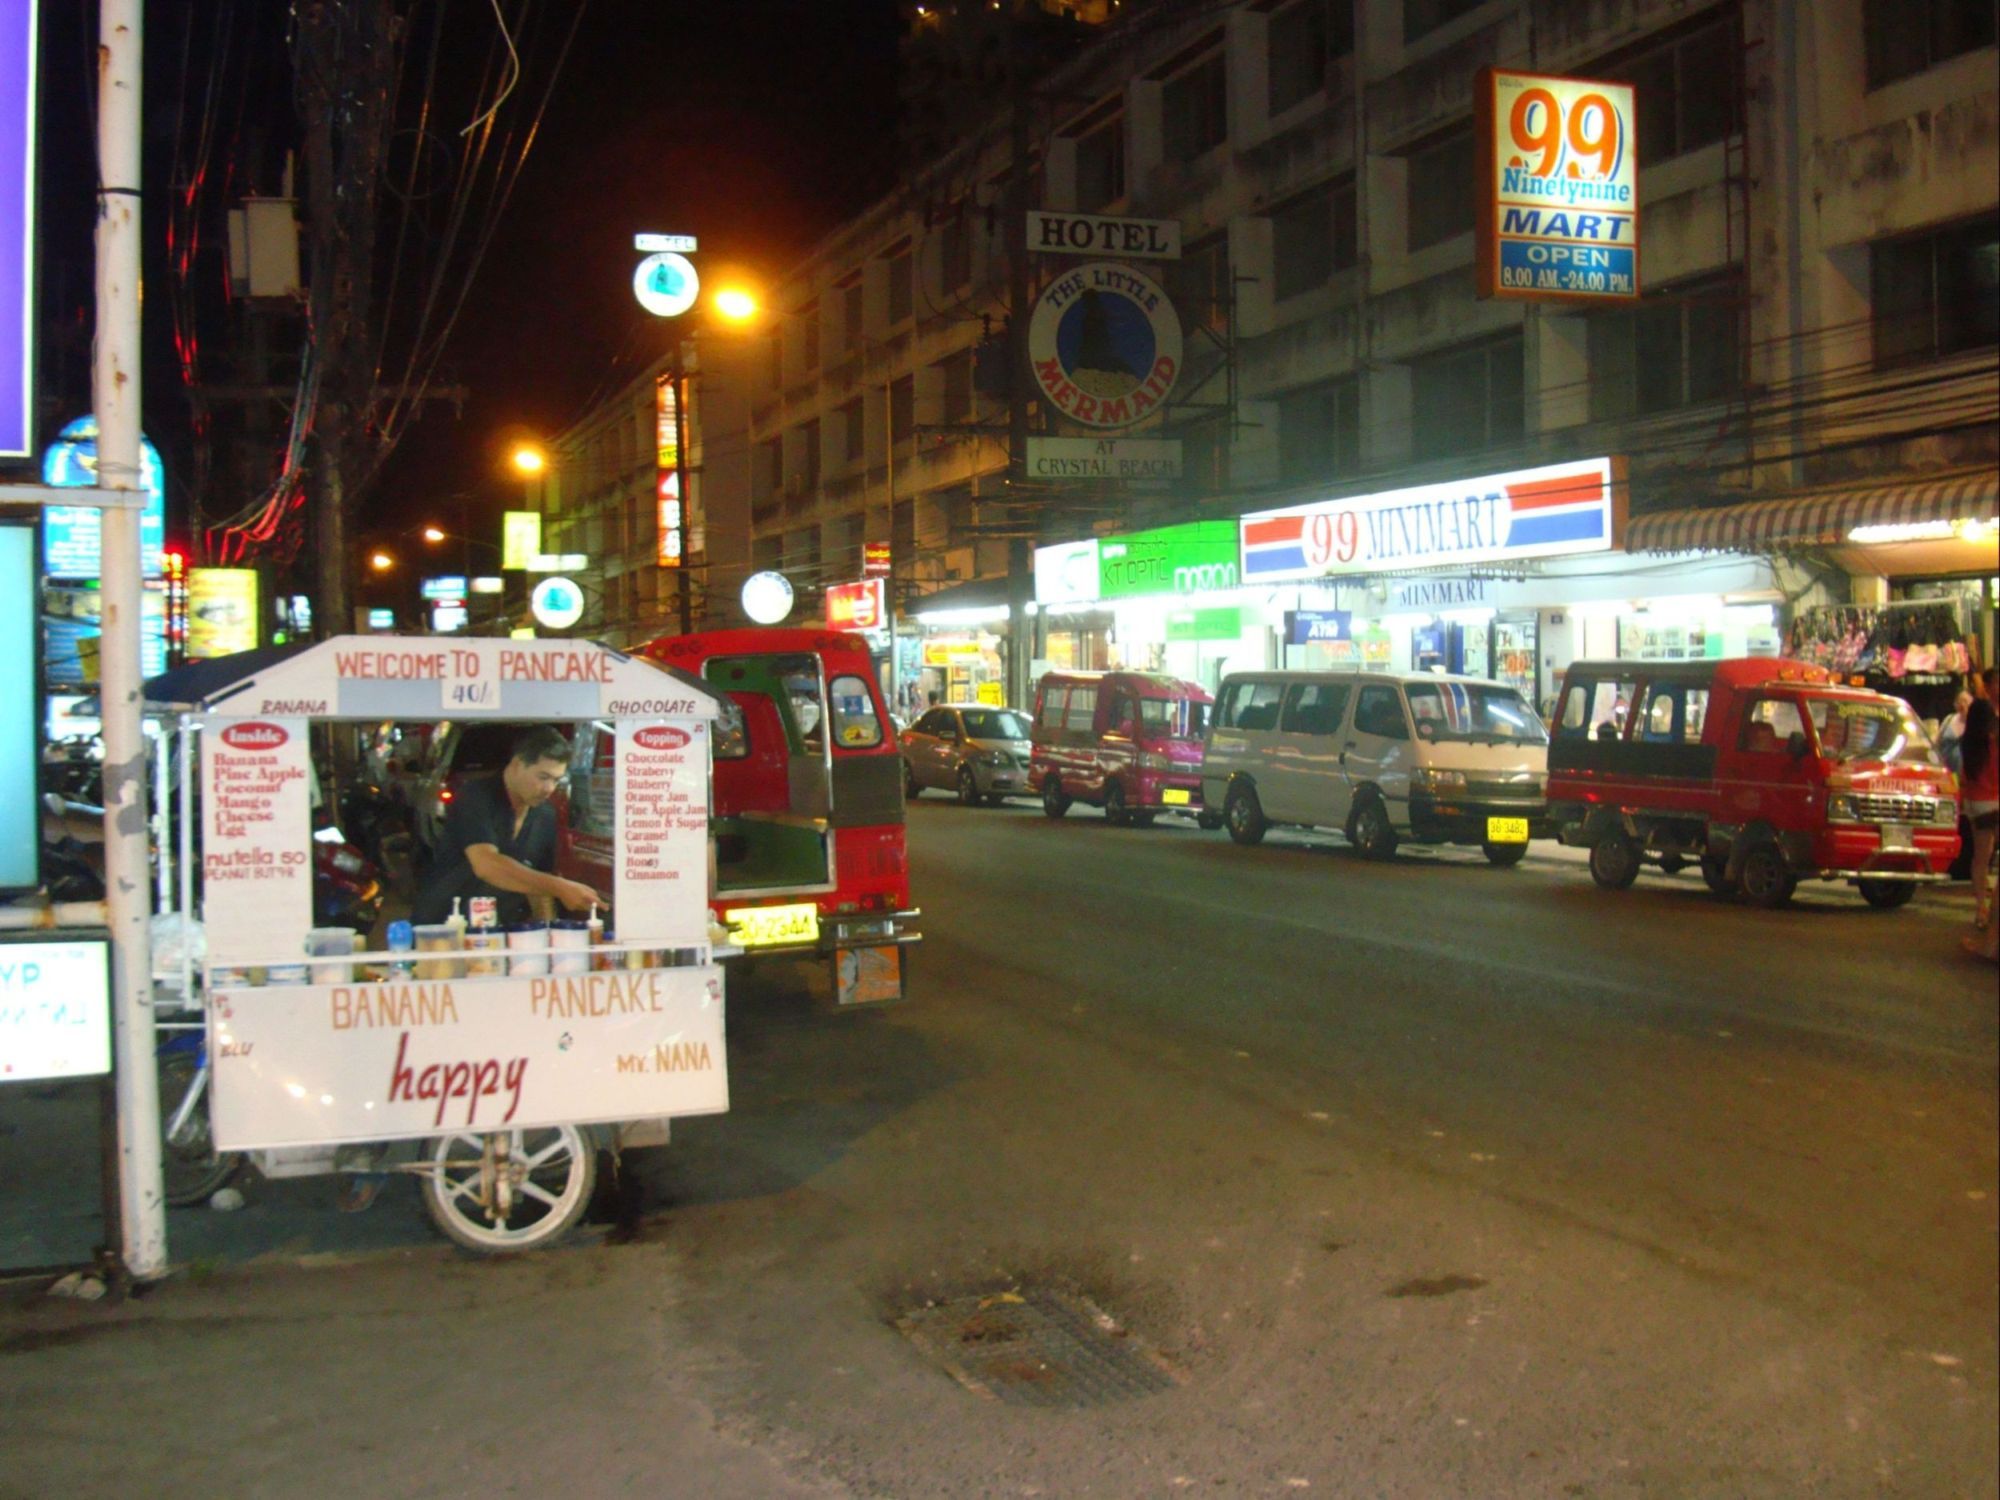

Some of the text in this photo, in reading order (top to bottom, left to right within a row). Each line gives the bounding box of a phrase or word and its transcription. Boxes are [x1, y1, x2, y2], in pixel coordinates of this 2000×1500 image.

[1509, 87, 1622, 181] 99
[1502, 166, 1631, 204] Ninetynine
[1503, 208, 1631, 241] MART
[1039, 217, 1168, 253] HOTEL
[1527, 244, 1610, 268] OPEN
[1503, 266, 1533, 287] 8.00
[1046, 269, 1158, 313] THE LITTLE
[1034, 355, 1176, 424] MERMAID
[1096, 440, 1116, 455] AT
[1037, 457, 1174, 476] CRYSTAL BEACH
[1311, 493, 1501, 565] 99 MINIMART
[1399, 579, 1487, 606] MINIMART
[1308, 620, 1338, 638] ATM
[450, 649, 480, 678] TO
[499, 650, 614, 683] PANCAKE
[260, 700, 327, 714] BANANA
[608, 699, 696, 714] CHOCOLATE
[639, 731, 684, 746] Topping
[213, 753, 278, 766] Banana
[213, 766, 305, 783] Pine Apple
[216, 795, 271, 809] Mango
[668, 792, 689, 802] Jam
[215, 810, 274, 822] Cheese
[625, 803, 707, 818] Pine Apple Jam
[215, 822, 247, 837] Egg
[625, 818, 661, 829] Lemon
[676, 818, 707, 831] Sugar
[625, 830, 669, 841] Caramel
[207, 849, 274, 867] nutella
[625, 869, 680, 880] Cinnamon
[331, 972, 664, 1029] BANANA PANCAKE
[656, 1041, 712, 1072] NANA
[388, 1032, 529, 1127] happy
